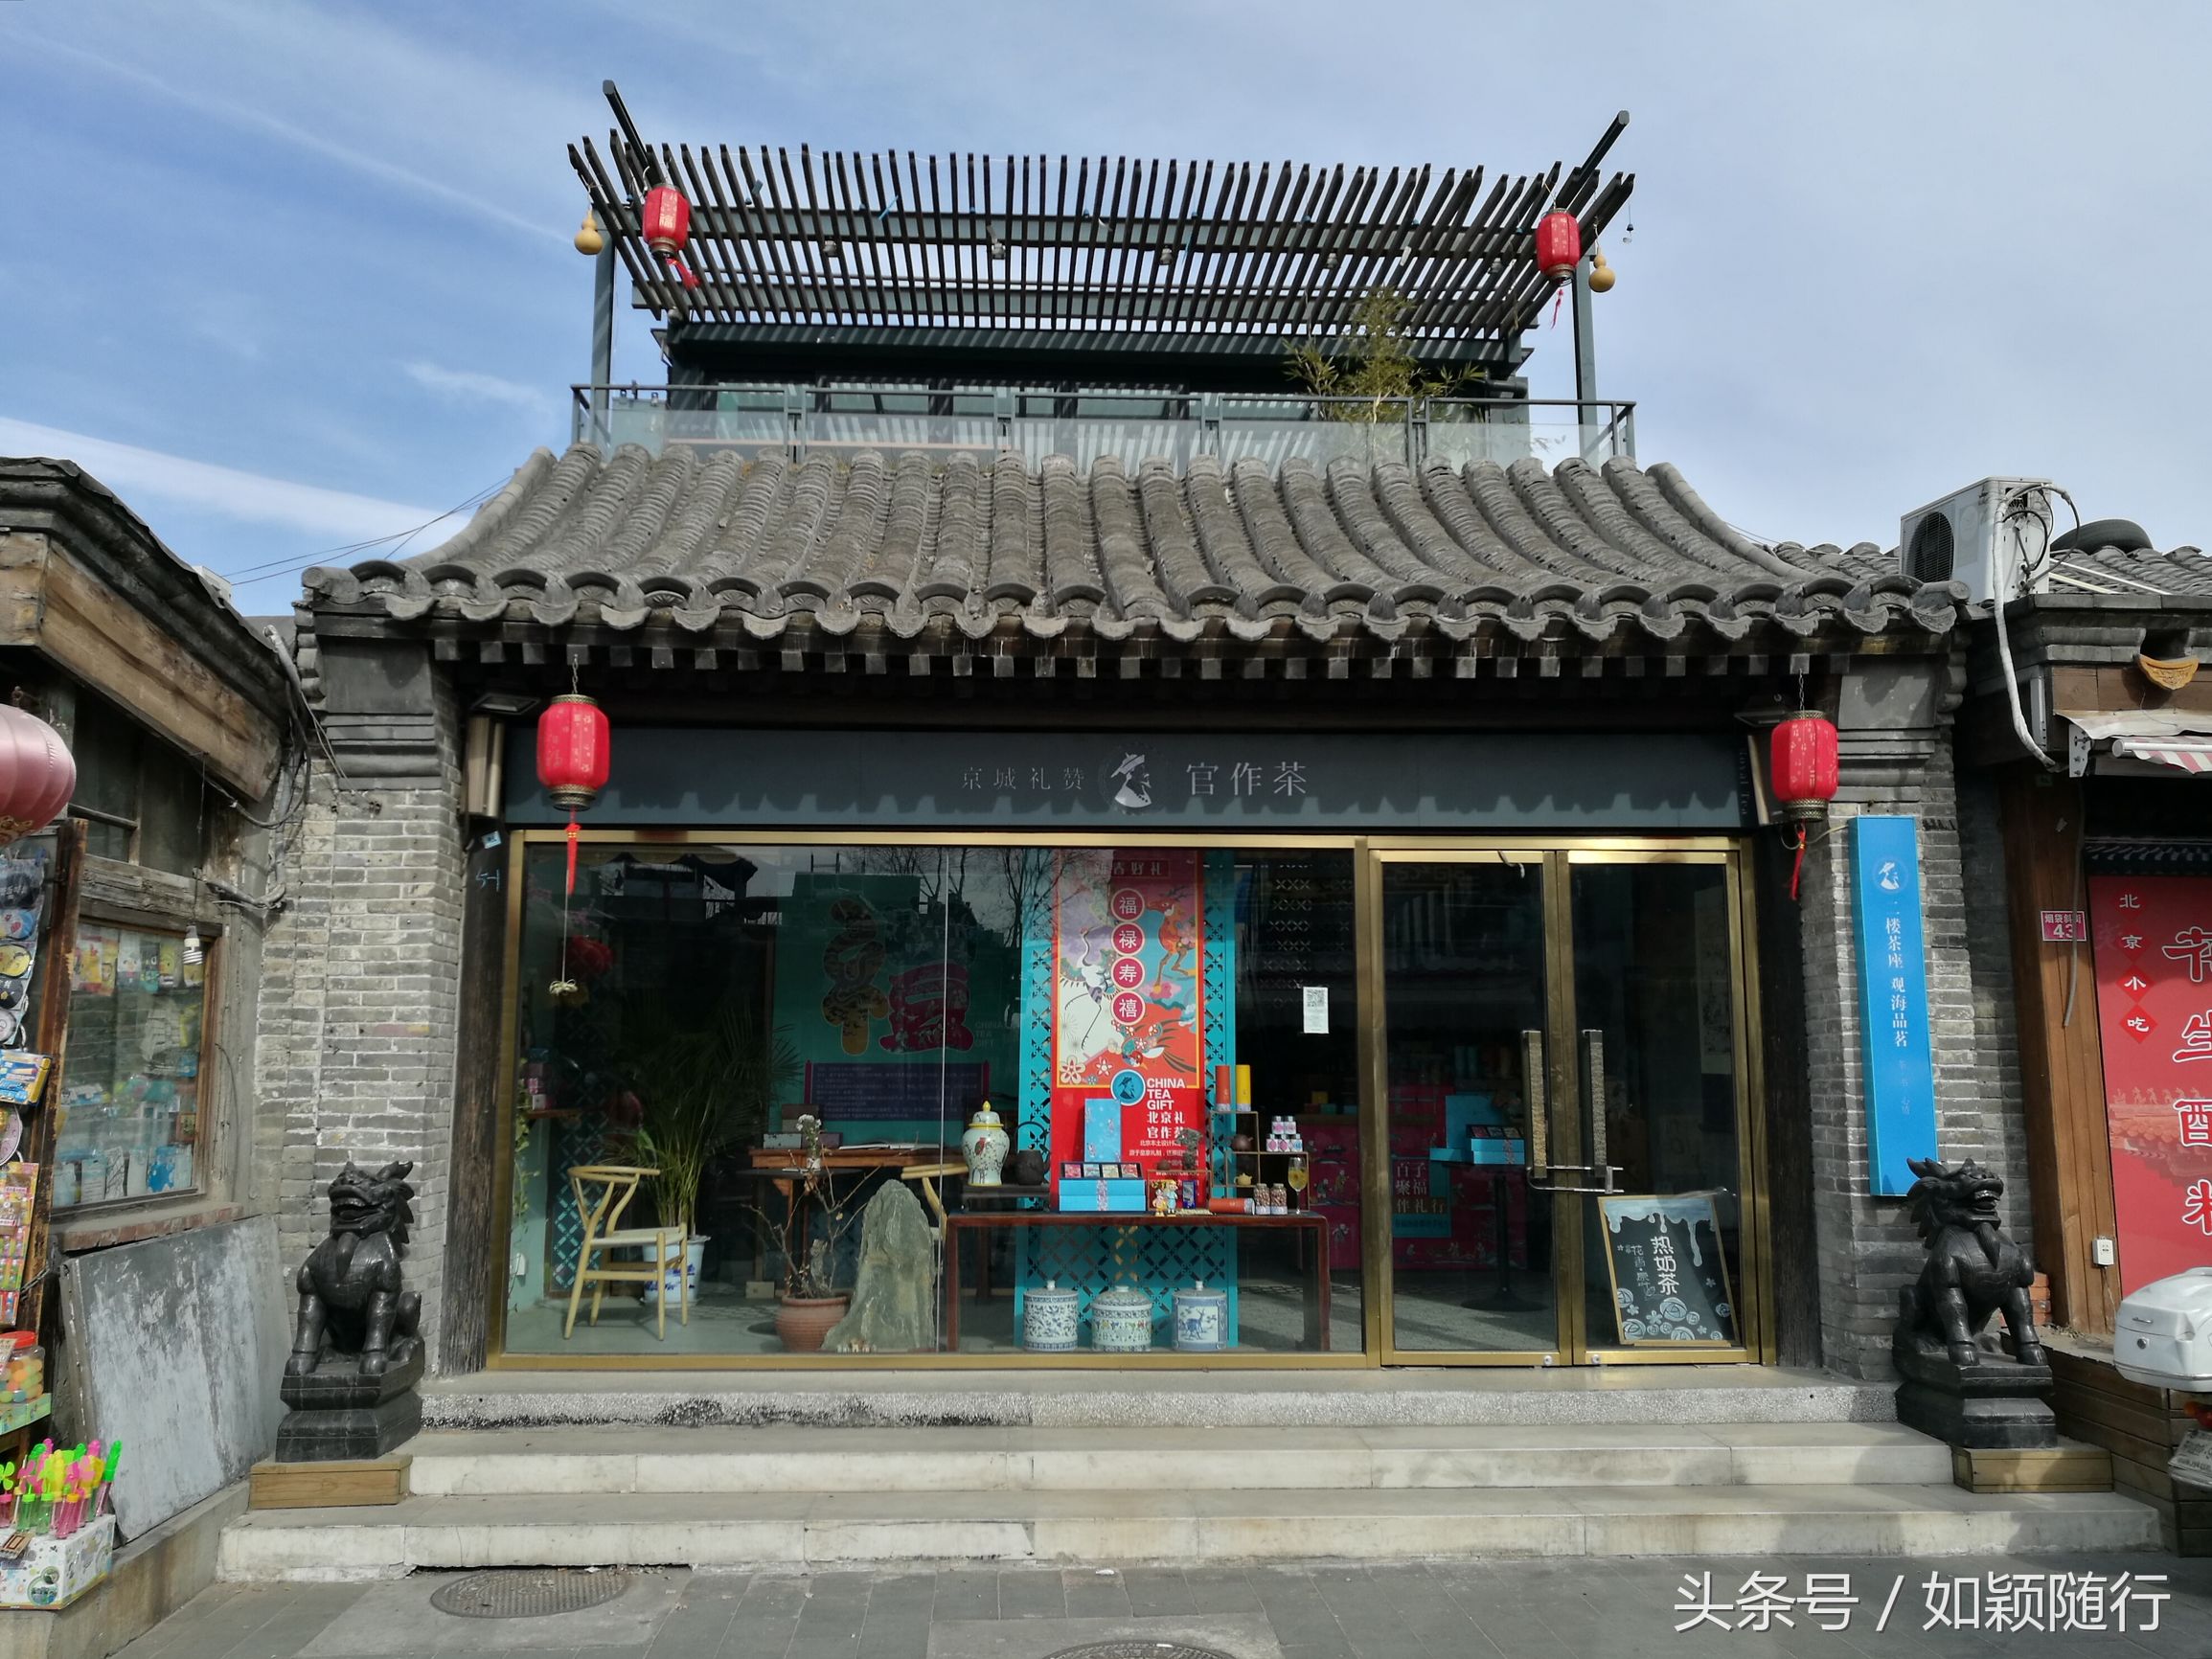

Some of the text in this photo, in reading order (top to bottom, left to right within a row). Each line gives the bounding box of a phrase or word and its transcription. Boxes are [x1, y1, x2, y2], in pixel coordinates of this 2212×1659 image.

[962, 761, 1307, 796] 京城礼赞 官作茶
[1885, 900, 1904, 969] 二楼茶座
[2053, 923, 2074, 938] 43
[1119, 897, 1137, 1018] 福禄寿禧
[2119, 894, 2150, 1032] 北京小吃
[1891, 977, 1908, 1047] 观海品茗
[1147, 1078, 1185, 1088] CHINA
[1147, 1089, 1172, 1099] TEA
[1147, 1100, 1174, 1110] GIFT
[1147, 1111, 1185, 1124] 北京礼
[1651, 1236, 1679, 1296] 热奶茶
